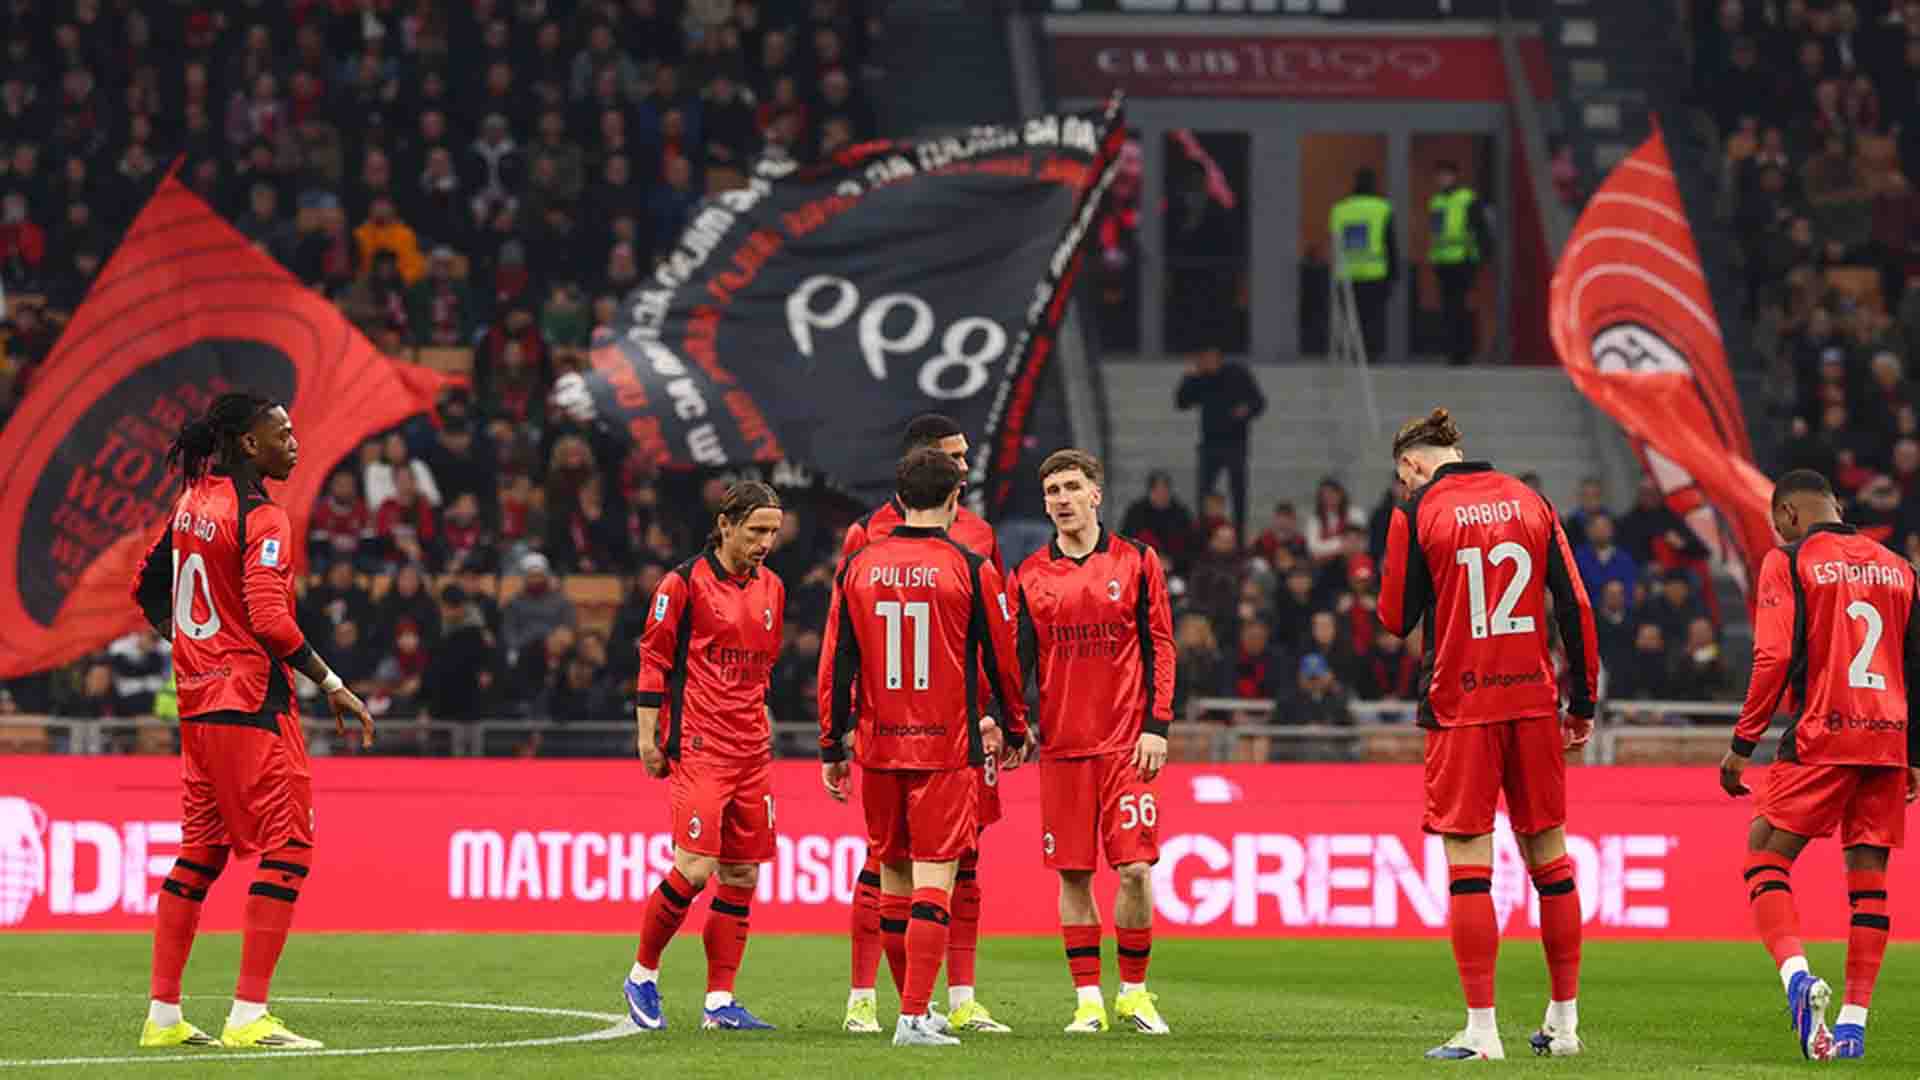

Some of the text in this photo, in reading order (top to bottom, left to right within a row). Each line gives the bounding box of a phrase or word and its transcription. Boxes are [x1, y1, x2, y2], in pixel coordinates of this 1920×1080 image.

[1454, 499, 1523, 529] RABIOT
[172, 547, 222, 642] 10
[868, 565, 941, 588] PULISIC
[1455, 541, 1537, 641] 12
[874, 600, 931, 691] 11
[1845, 600, 1888, 691] 2
[761, 792, 776, 830] 1
[1118, 793, 1158, 829] 56
